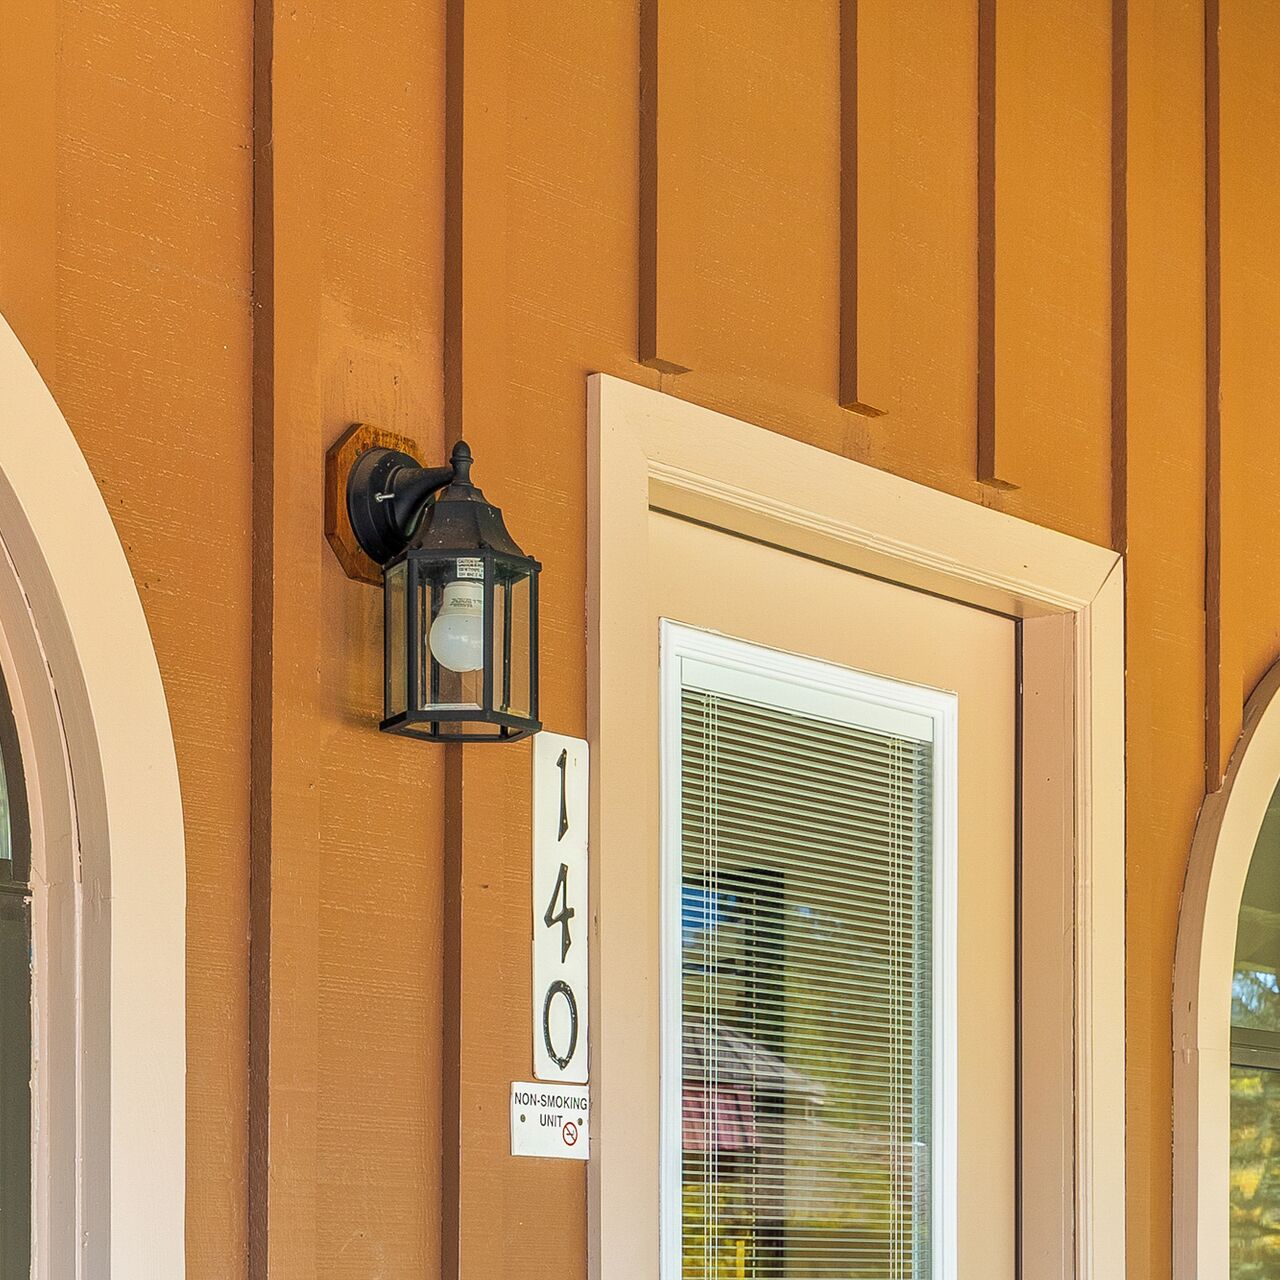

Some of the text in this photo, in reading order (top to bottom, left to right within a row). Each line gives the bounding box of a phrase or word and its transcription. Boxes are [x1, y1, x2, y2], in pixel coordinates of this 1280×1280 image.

[543, 748, 578, 1070] 140
[514, 1092, 588, 1111] NON-SMOKING
[539, 1113, 563, 1128] UNIT
